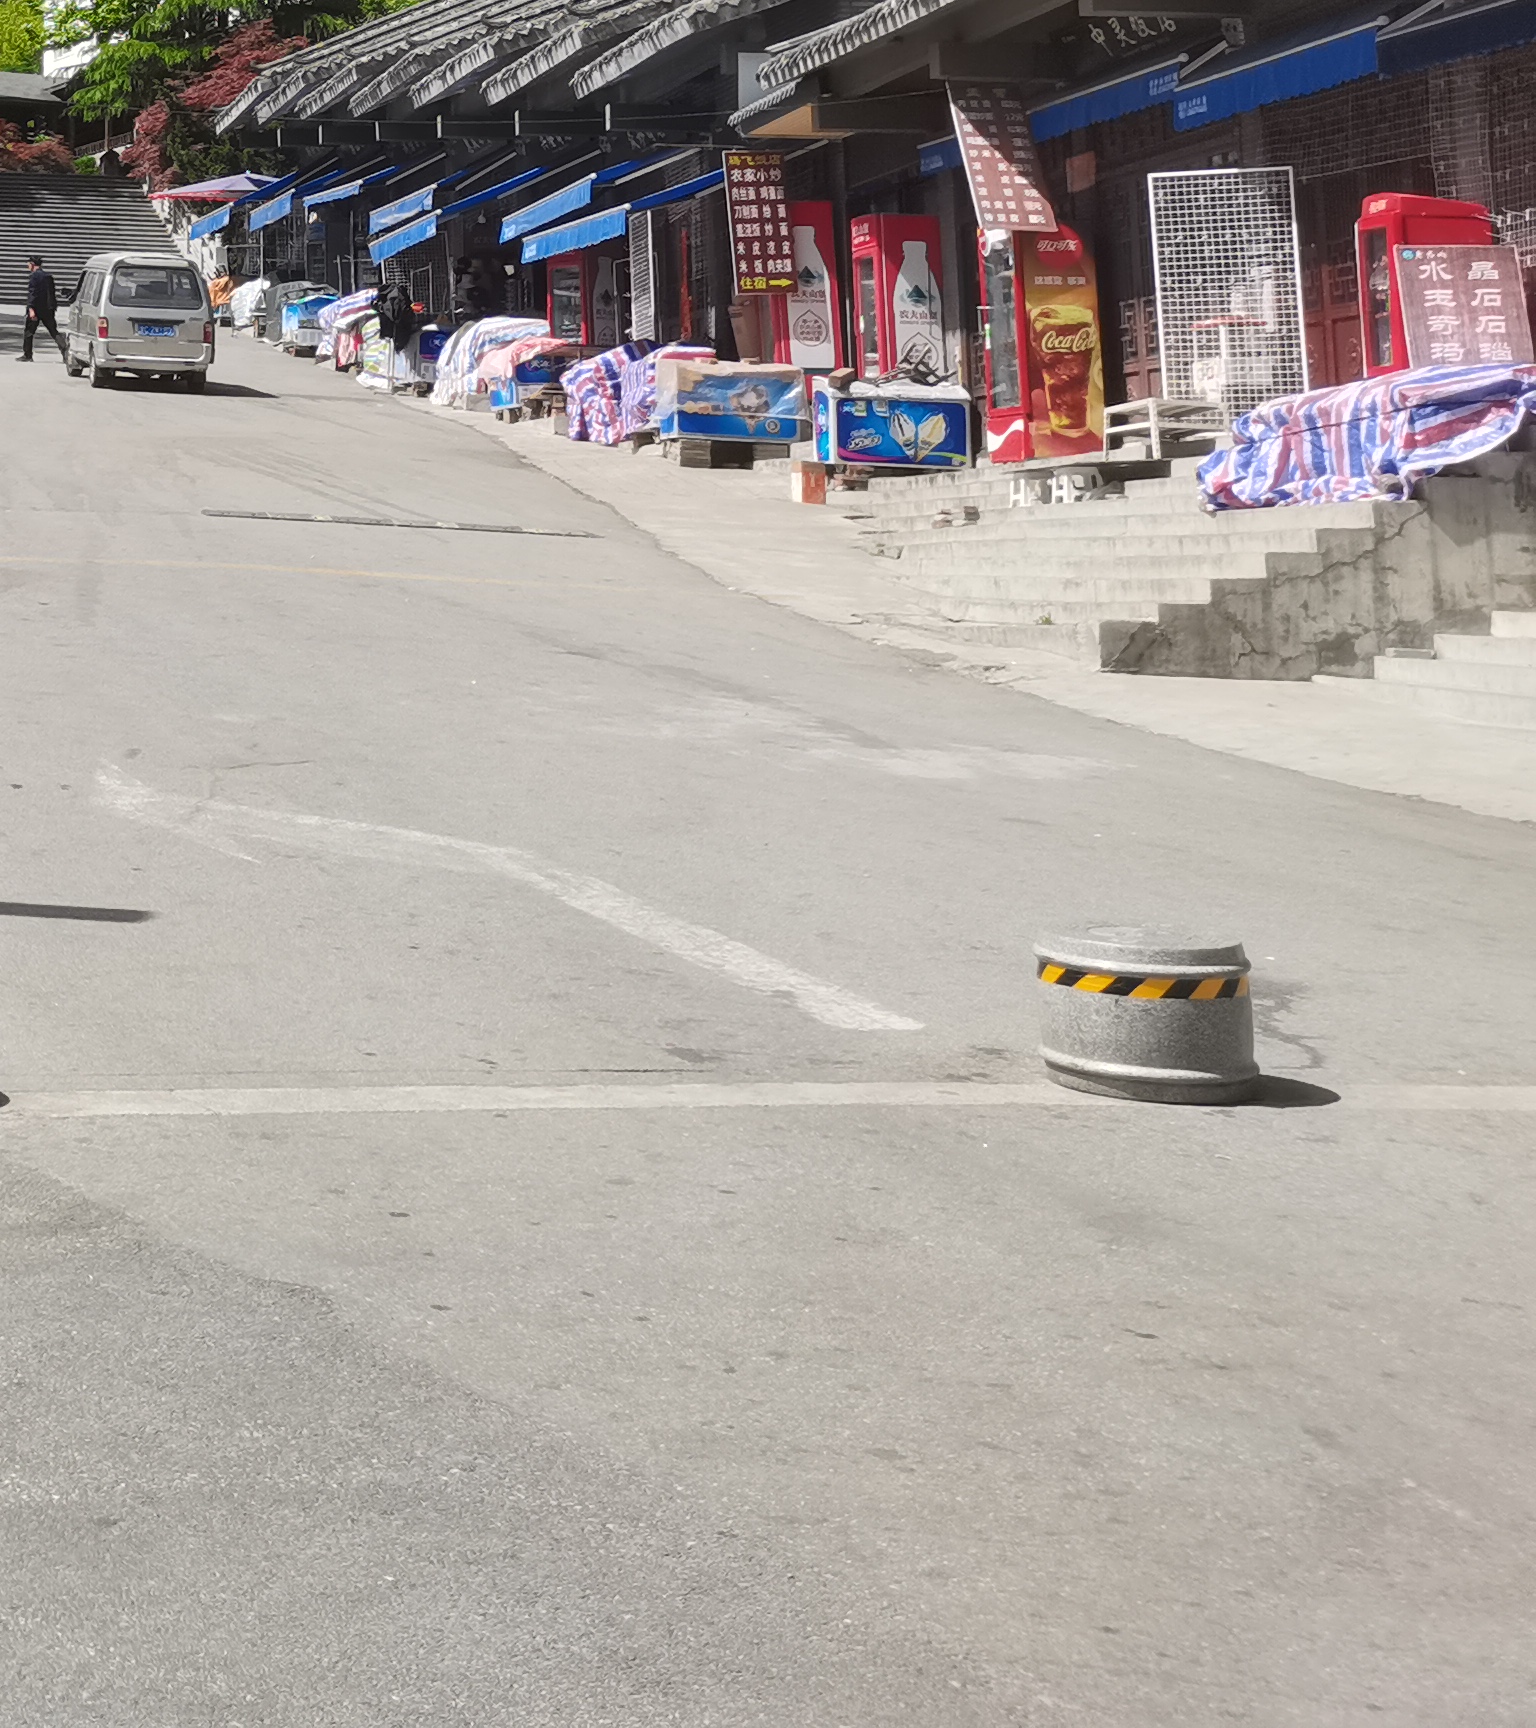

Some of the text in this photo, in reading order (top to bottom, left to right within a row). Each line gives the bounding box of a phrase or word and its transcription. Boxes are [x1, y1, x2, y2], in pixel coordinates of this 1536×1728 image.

[730, 168, 782, 183] 农家小炒
[1036, 239, 1079, 252] 可口可乐
[1418, 261, 1499, 281] 水晶
[740, 276, 767, 290] 住宿
[1423, 288, 1502, 308] 玉石
[1426, 315, 1506, 335] 奇石
[1430, 341, 1513, 362] 玛瑙
